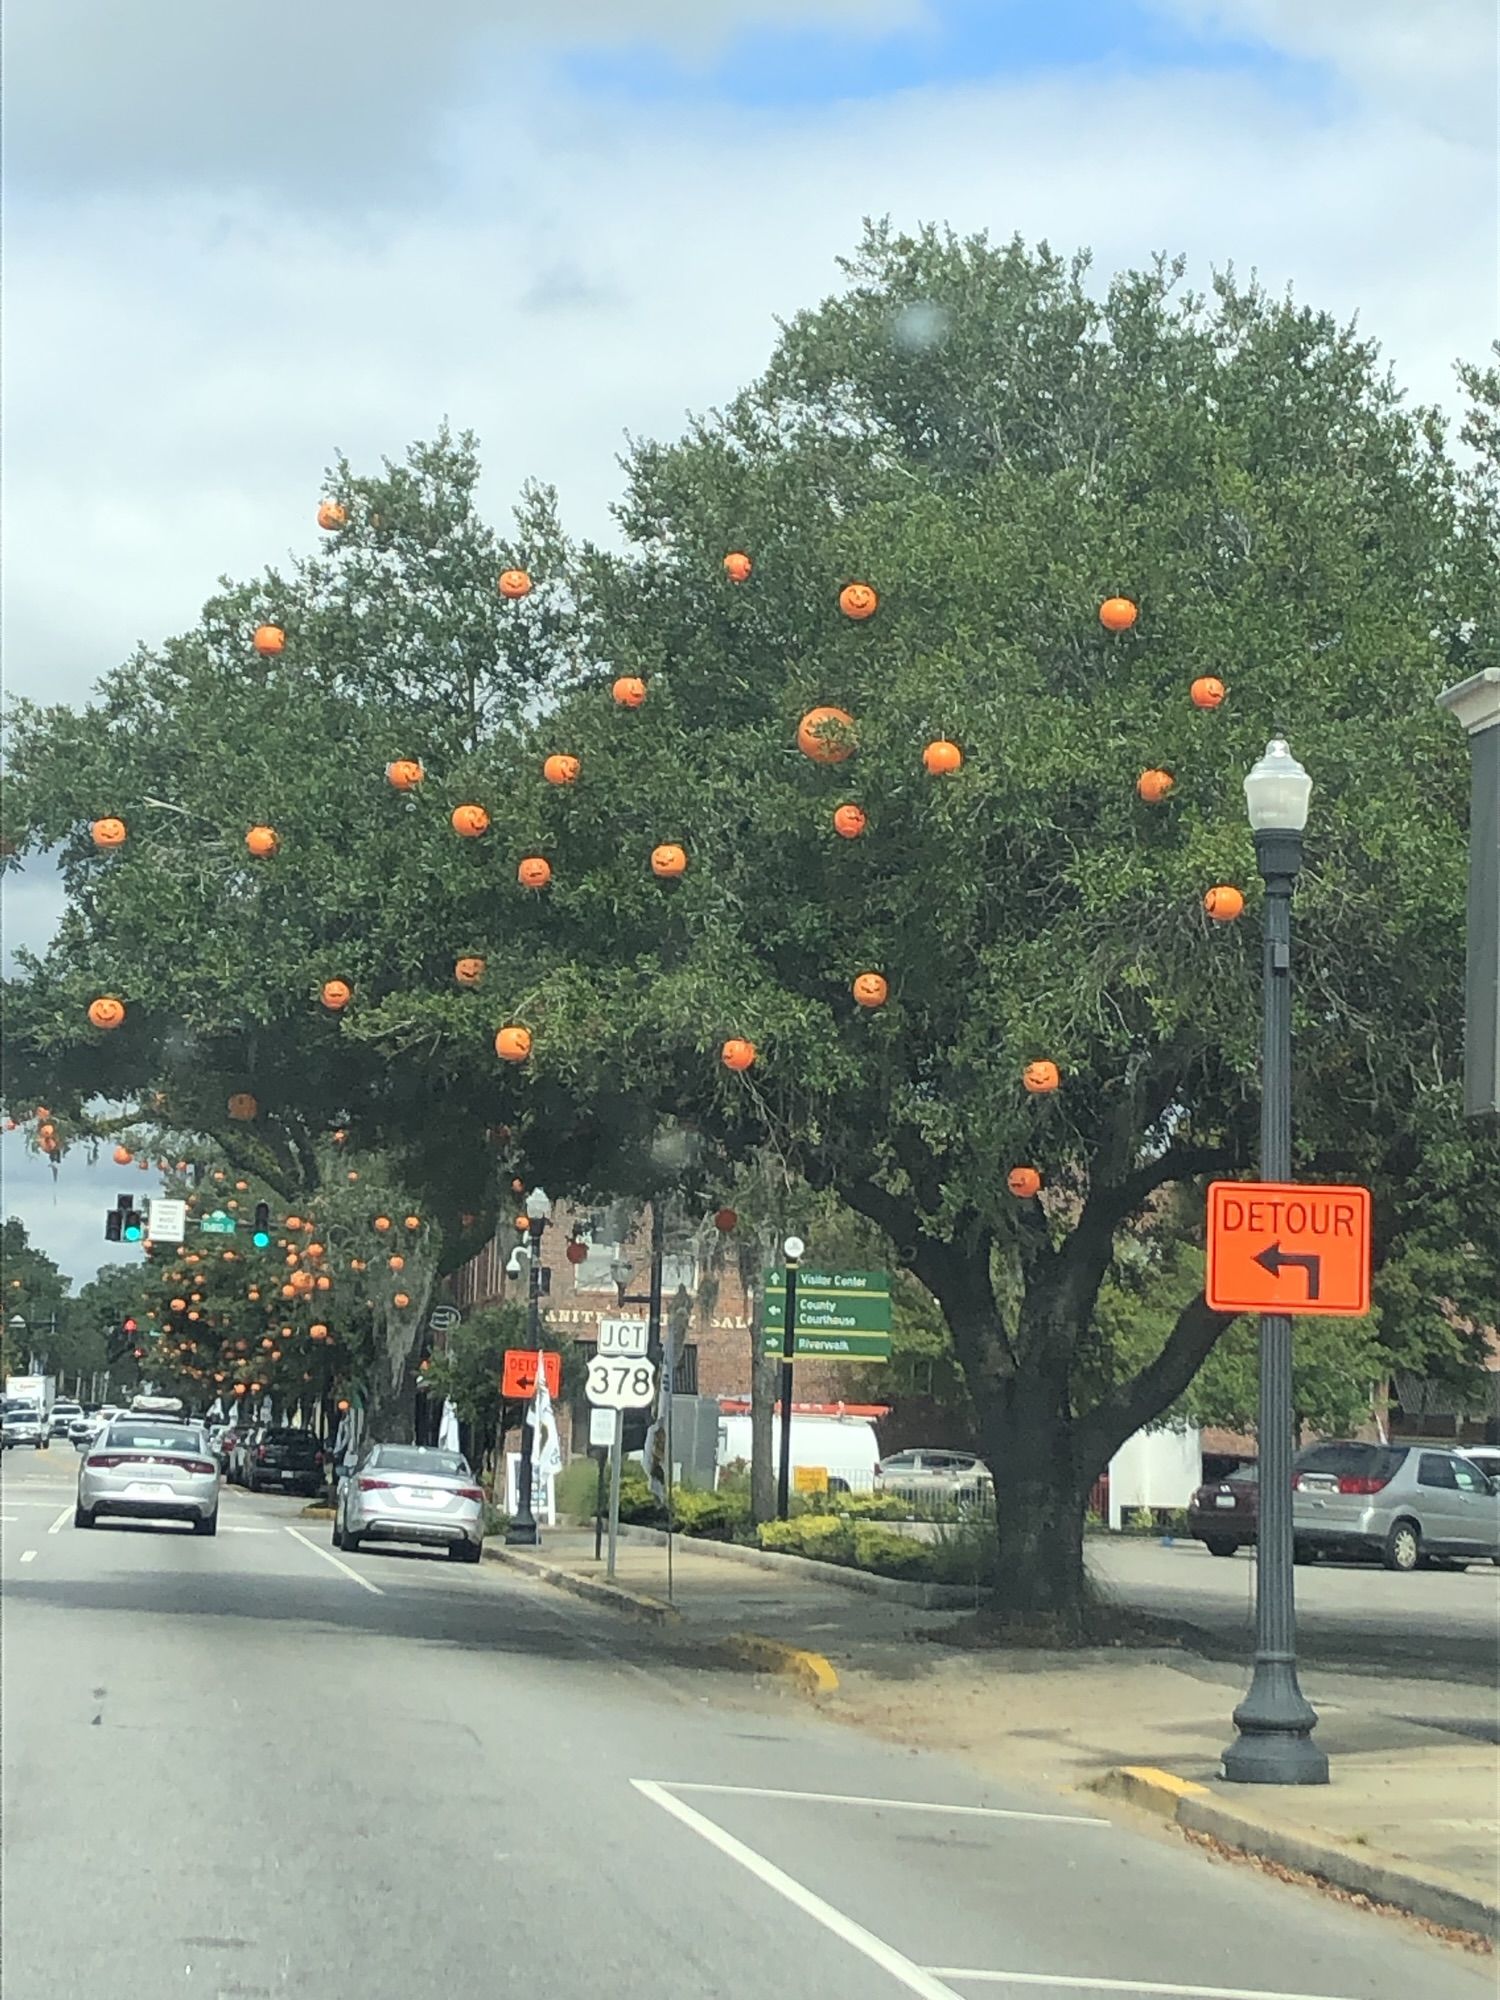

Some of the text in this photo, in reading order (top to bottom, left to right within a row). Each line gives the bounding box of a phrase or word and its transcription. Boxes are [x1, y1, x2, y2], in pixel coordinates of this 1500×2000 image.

[1222, 1199, 1355, 1237] DETOUR
[800, 1274, 867, 1287] Visitor Center
[799, 1299, 837, 1313] County
[799, 1313, 856, 1326] Courthouse
[602, 1325, 643, 1348] JCT
[798, 1338, 850, 1352] Riverwalk
[510, 1357, 555, 1371] DETOR
[592, 1367, 650, 1396] 378
